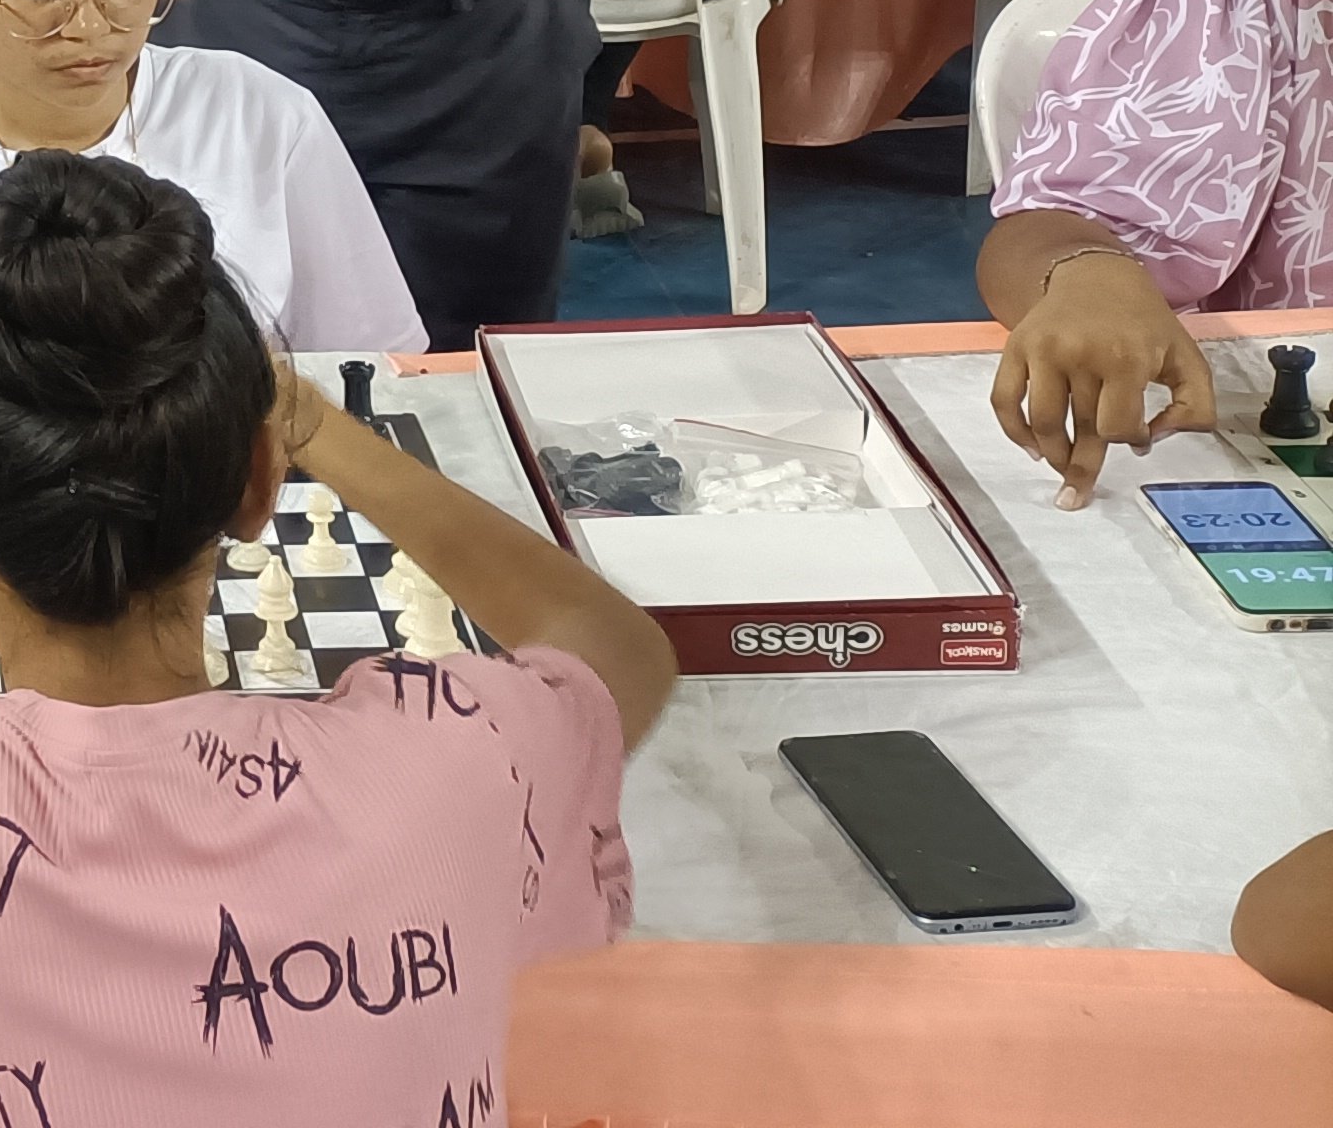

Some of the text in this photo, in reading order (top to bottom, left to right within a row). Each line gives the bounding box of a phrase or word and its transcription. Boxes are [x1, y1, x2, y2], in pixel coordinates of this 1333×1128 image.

[1181, 512, 1291, 528] 20:23
[1226, 566, 1333, 583] 19:47
[733, 623, 881, 667] chess
[192, 903, 458, 1059] AOUBI
